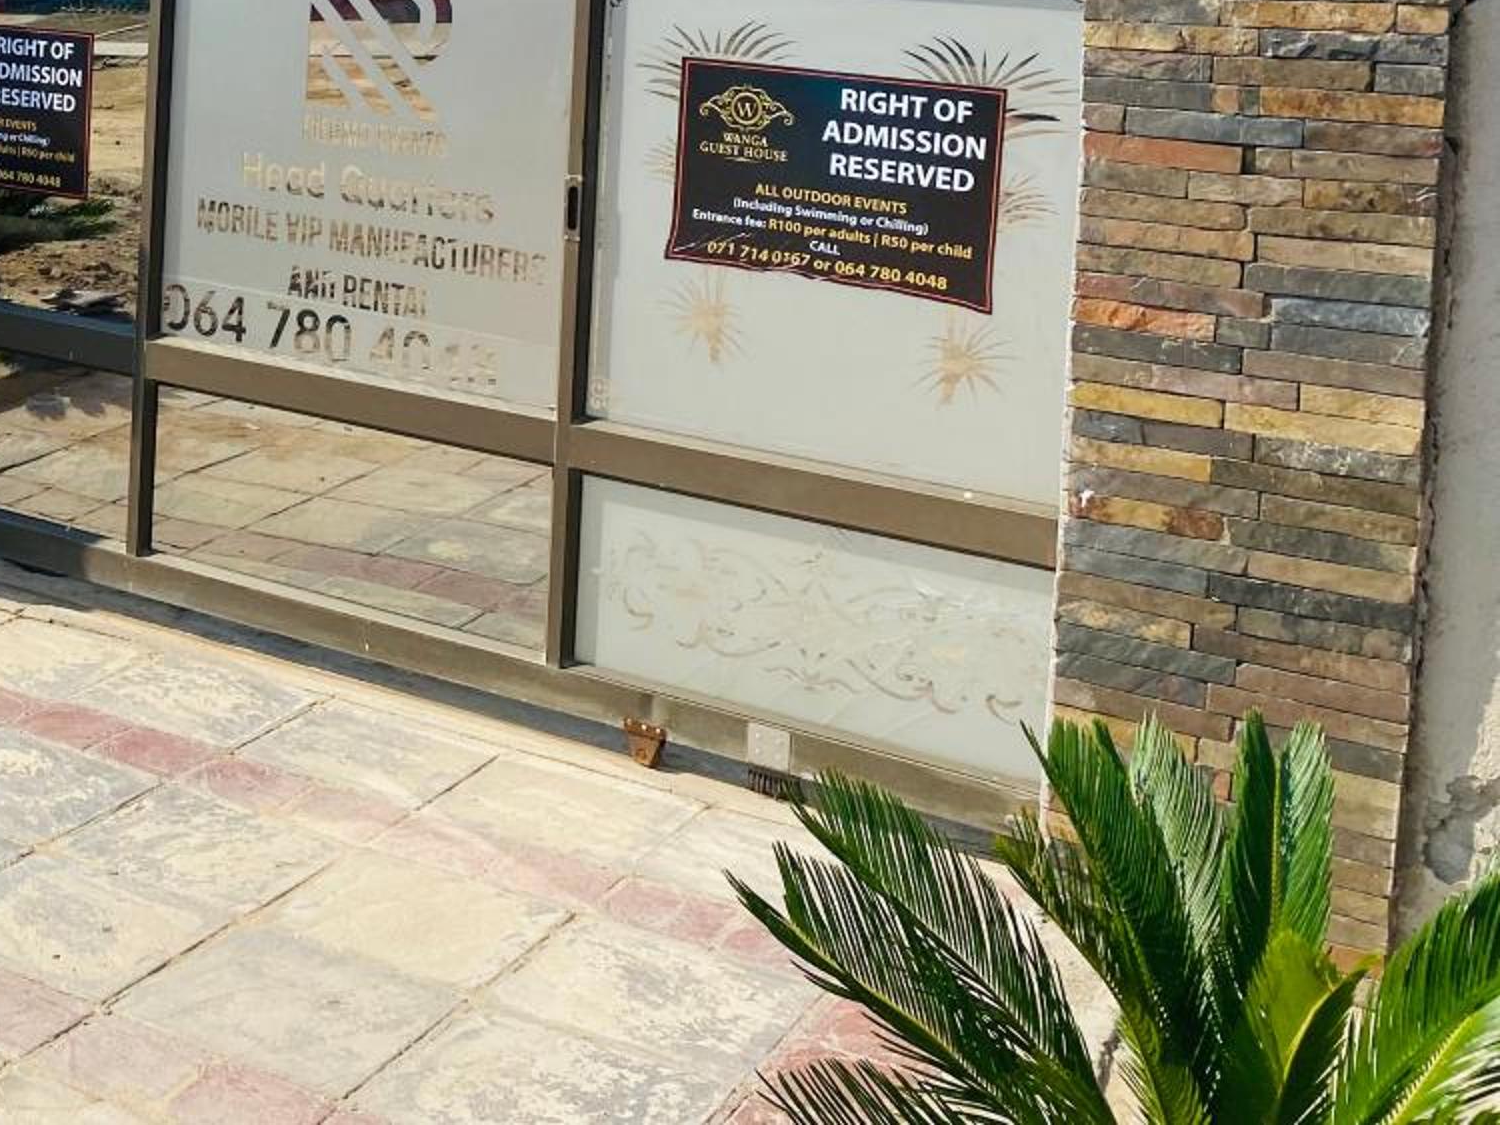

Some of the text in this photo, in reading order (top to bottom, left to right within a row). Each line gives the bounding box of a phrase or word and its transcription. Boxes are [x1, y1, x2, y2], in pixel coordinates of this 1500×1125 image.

[50, 40, 75, 61] OF
[840, 88, 974, 124] RIGHT OF
[699, 140, 789, 162] GUEST HOUSE
[723, 132, 769, 148] WANGA
[821, 119, 988, 161] ADMISSION
[240, 150, 326, 199] Head
[829, 152, 976, 193] RESERVED
[733, 196, 929, 236] (Including Swimming or Chilling)
[755, 183, 908, 215] ALL OUTDOOR EVENTS
[196, 195, 279, 243] MOBILE
[285, 212, 325, 249] VIP
[692, 208, 974, 260] Entrance fee: R100 per adults R50 per child
[707, 240, 736, 255] 071
[739, 244, 769, 262] 714
[813, 259, 832, 271] or
[834, 260, 866, 276] 064
[868, 264, 901, 283] 780
[904, 270, 948, 291] 4048
[809, 240, 841, 256] CALL
[162, 282, 247, 345] 064
[265, 299, 352, 363] 780
